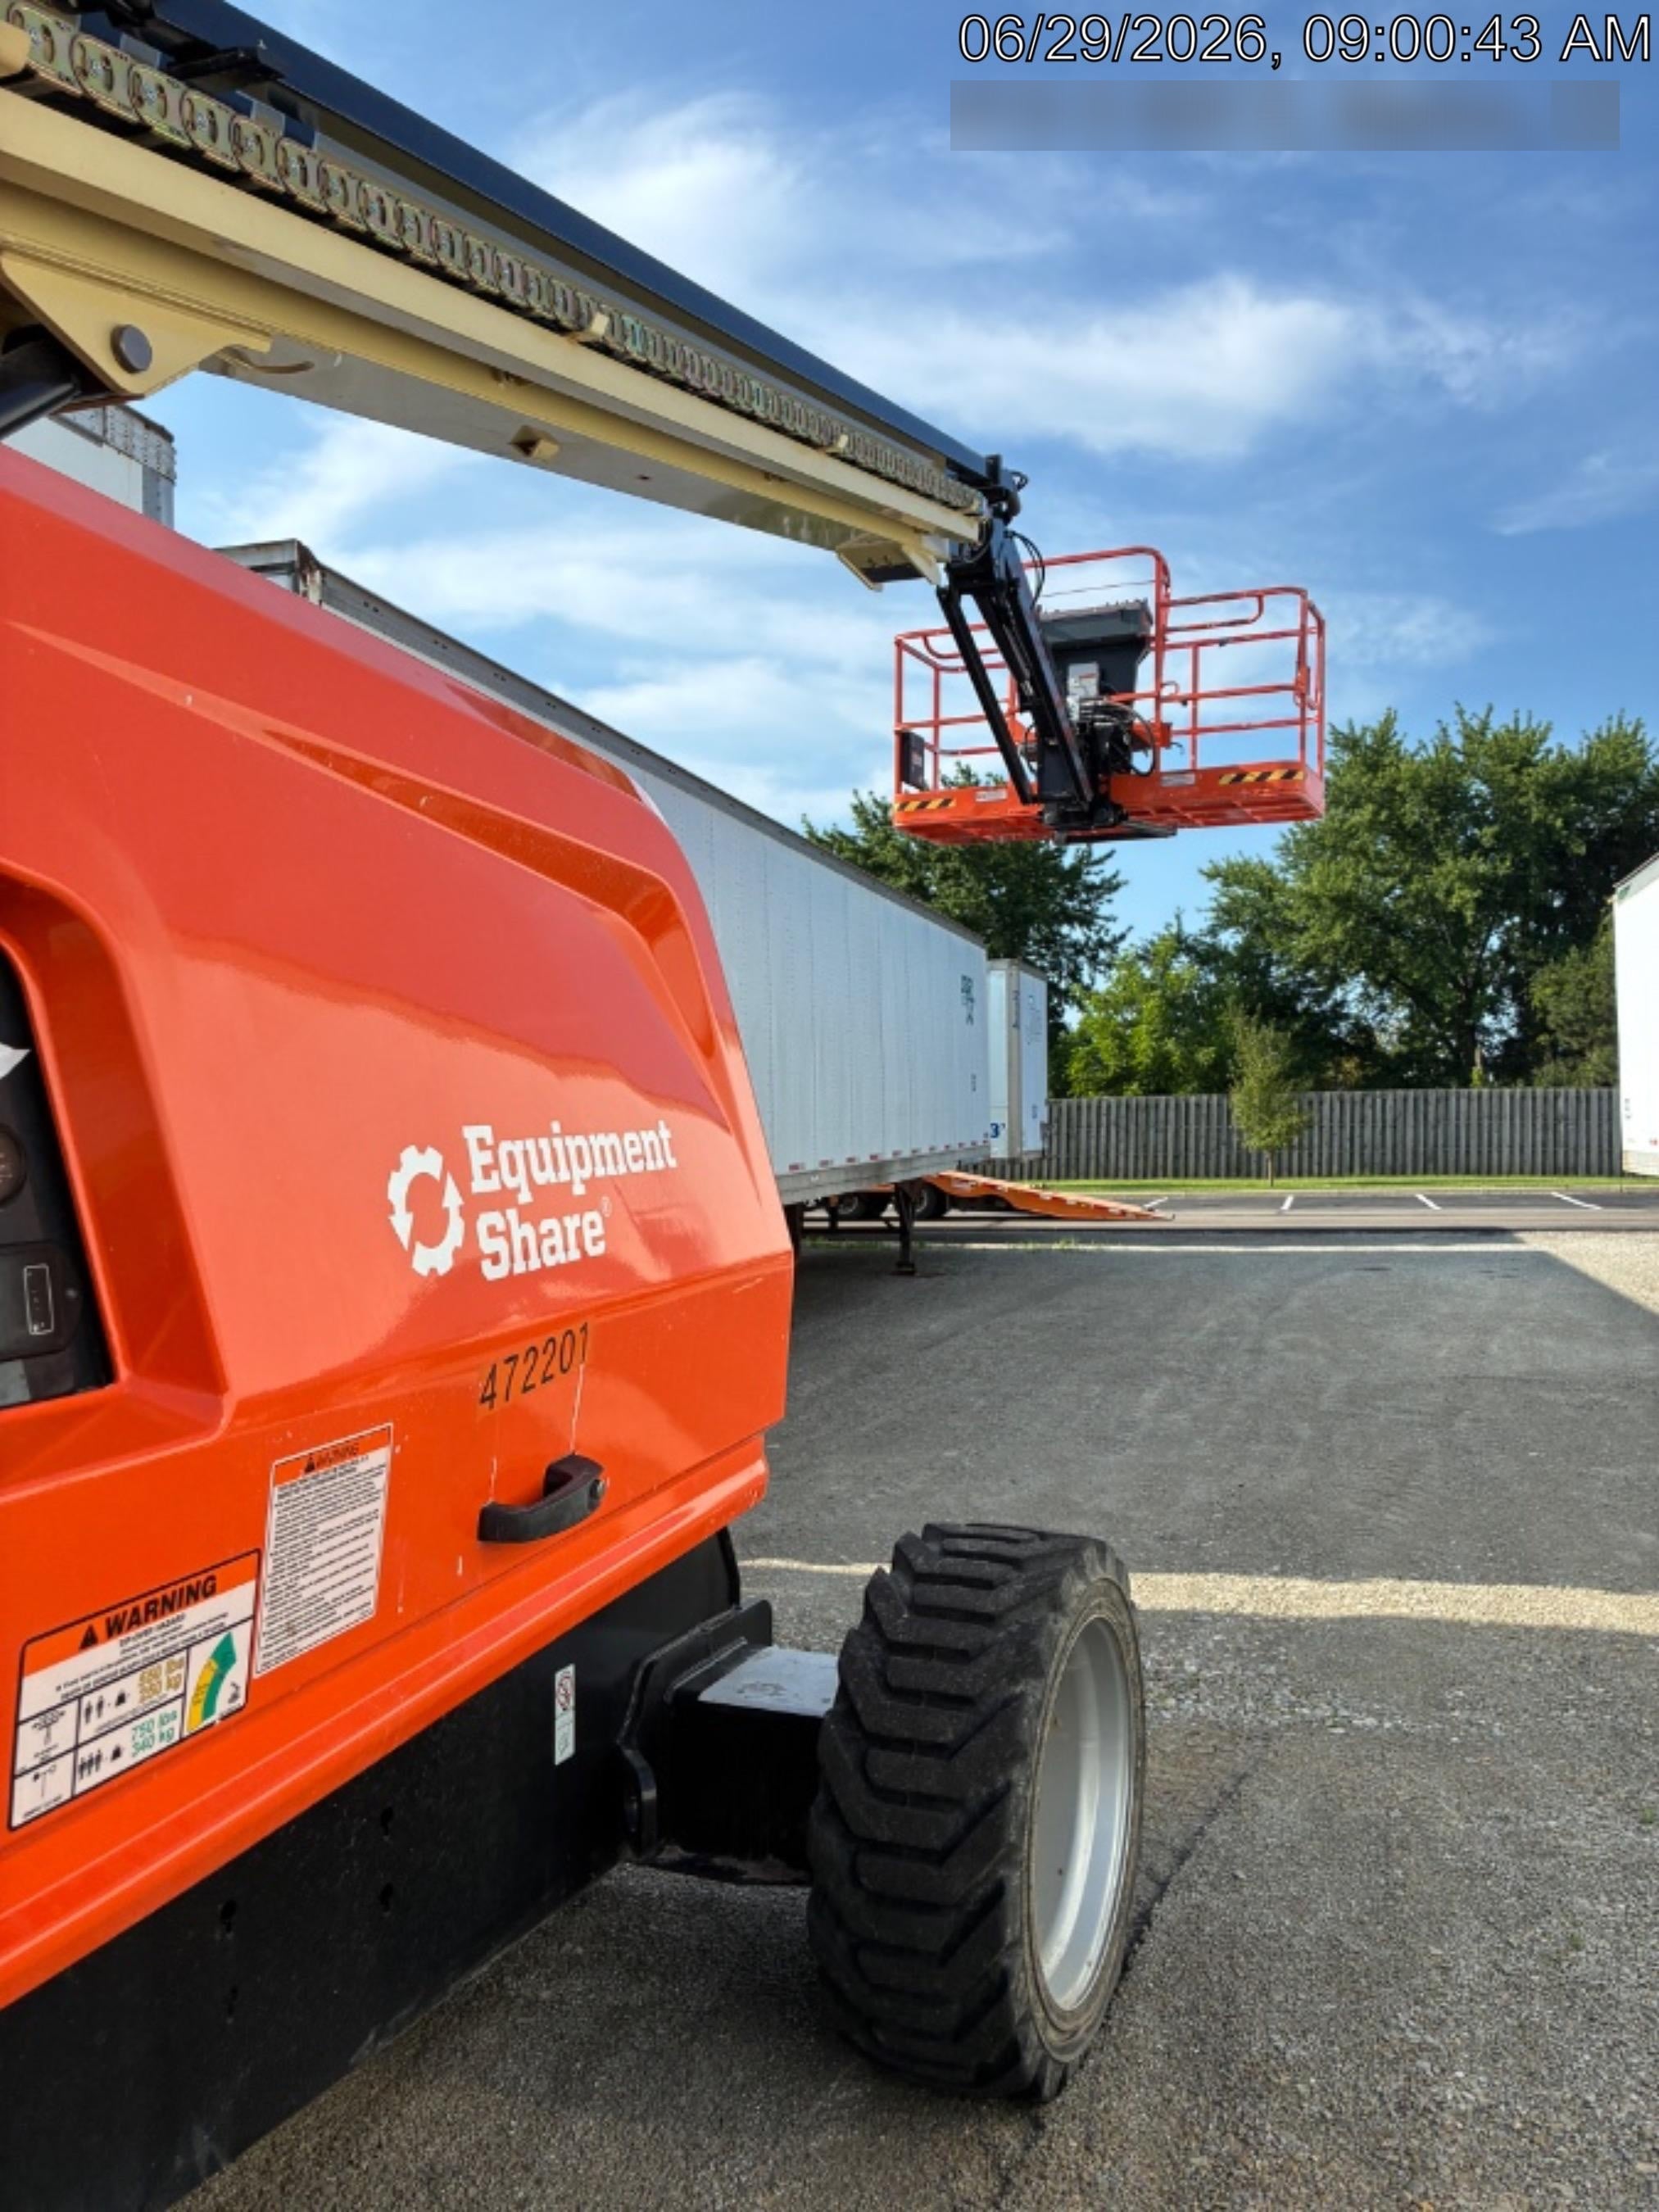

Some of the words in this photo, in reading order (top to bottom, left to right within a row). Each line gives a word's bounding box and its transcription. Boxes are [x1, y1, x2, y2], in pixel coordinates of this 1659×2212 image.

[461, 1119, 678, 1205] Equipment
[478, 1321, 590, 1410] 472201
[105, 1575, 218, 1639] WARNING
[132, 1717, 156, 1742] 750
[158, 1709, 178, 1726] lbs
[158, 1726, 175, 1743] kg
